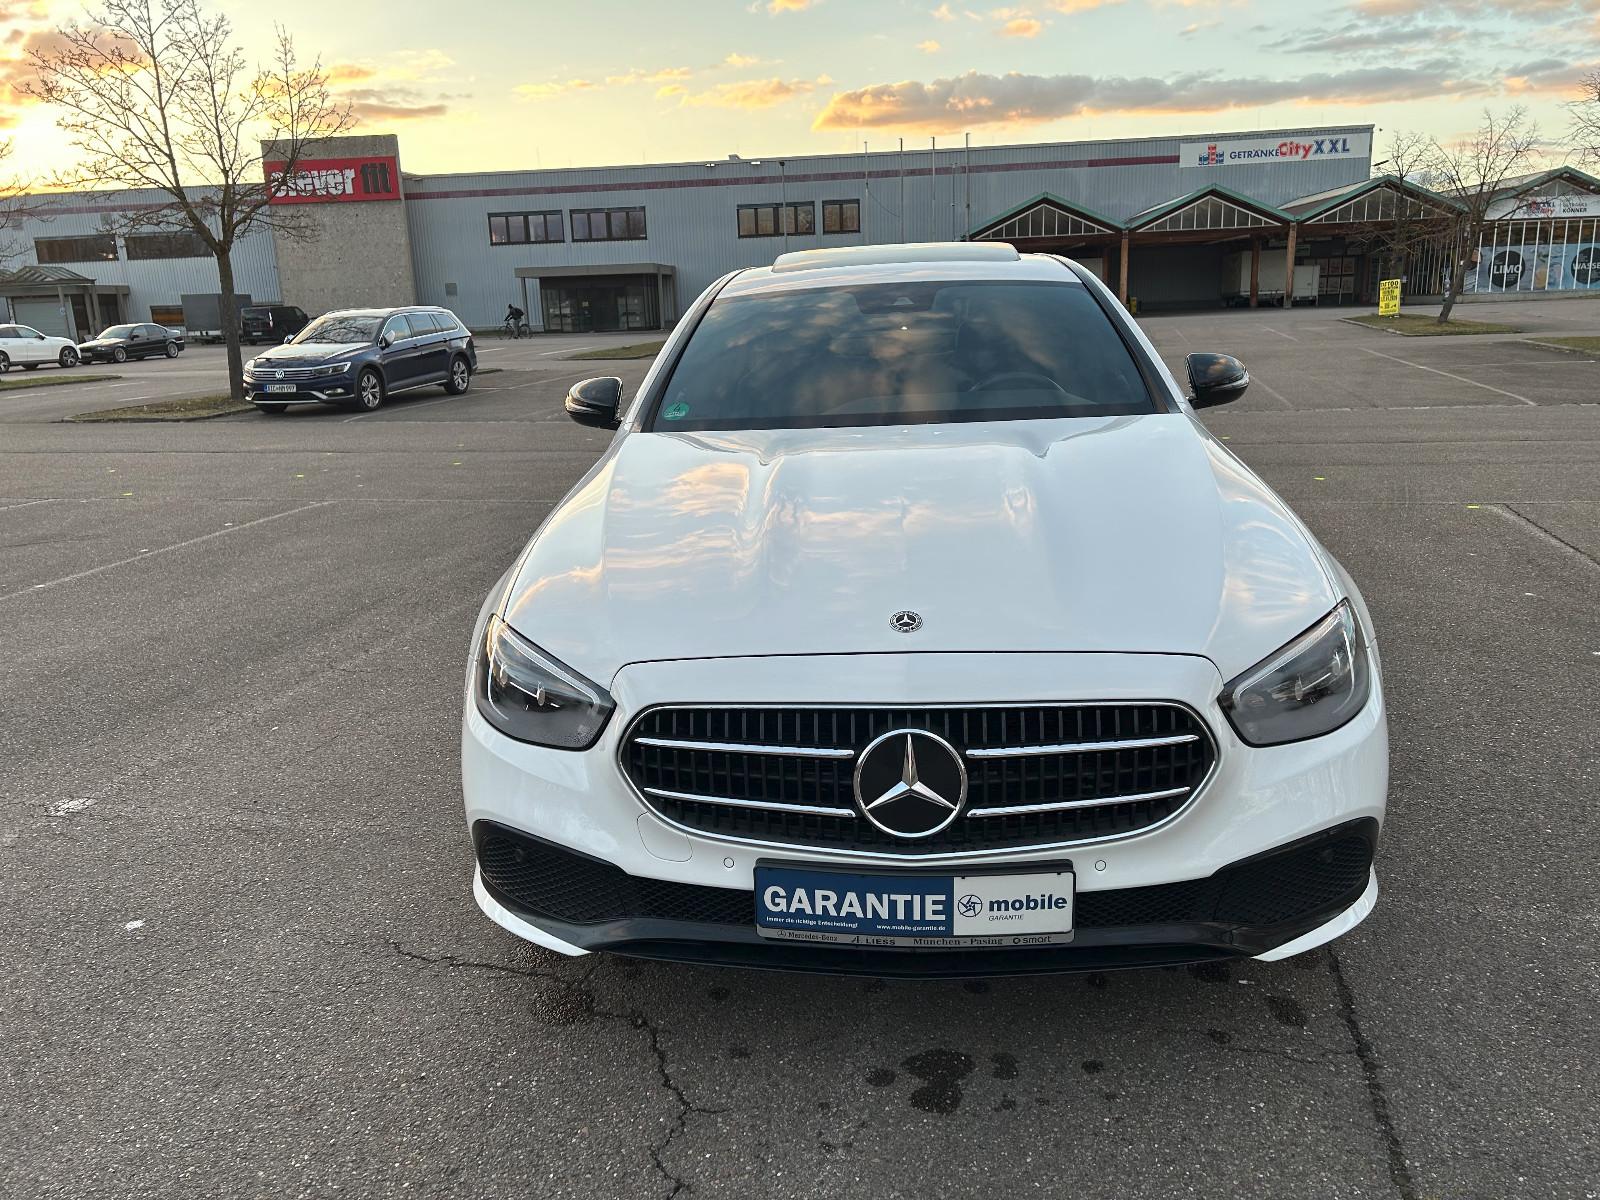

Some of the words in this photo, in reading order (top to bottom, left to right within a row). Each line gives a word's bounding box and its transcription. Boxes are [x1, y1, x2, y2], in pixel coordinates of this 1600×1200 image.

[1229, 148, 1280, 159] GETRÄNKE
[1279, 140, 1313, 159] City
[1313, 138, 1350, 154] XXL
[361, 163, 392, 193] fit
[1493, 264, 1522, 274] LIMO
[763, 885, 946, 921] GARANTIE
[988, 893, 1068, 912] mobile
[795, 918, 817, 926] richtige
[988, 913, 1024, 921] GARANTIE
[788, 931, 838, 942] Mercedes-Benz
[970, 937, 1004, 947] Pasing
[1022, 936, 1052, 944] smart
